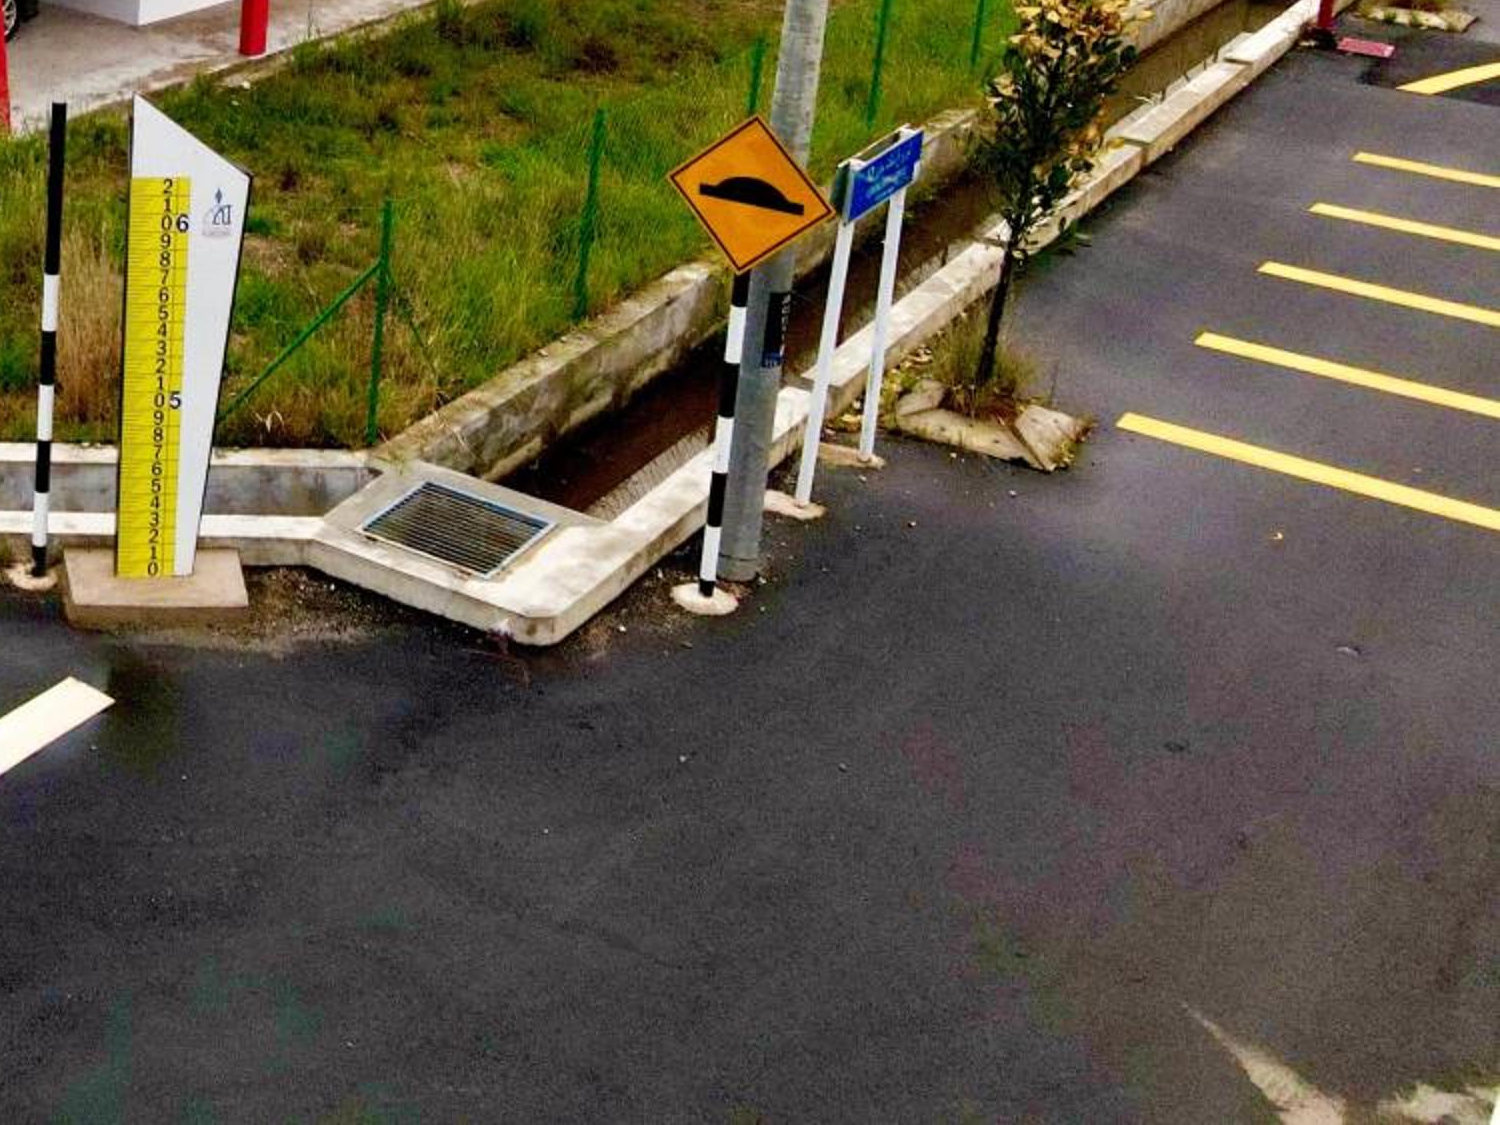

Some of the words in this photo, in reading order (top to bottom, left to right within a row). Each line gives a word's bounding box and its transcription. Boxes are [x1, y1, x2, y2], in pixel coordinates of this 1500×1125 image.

[164, 179, 172, 194] 2
[164, 198, 171, 212] 1
[162, 215, 172, 230] 0
[176, 213, 189, 233] 6
[161, 233, 170, 249] 9
[160, 251, 170, 267] 8
[161, 270, 169, 284] 7
[159, 287, 168, 302] 6
[159, 305, 168, 320] 5
[158, 323, 166, 336] 4
[158, 341, 166, 355] 3
[156, 358, 165, 373] 2
[157, 376, 164, 390] 1
[155, 393, 164, 407] 0
[169, 390, 181, 409] 5
[154, 411, 164, 425] 9
[154, 427, 163, 443] 8
[154, 445, 163, 459] 7
[152, 461, 162, 476] 6
[152, 478, 160, 493] 5
[151, 496, 159, 509] 4
[150, 512, 158, 526] 3
[150, 529, 158, 543] 2
[151, 547, 157, 559] 1
[148, 563, 158, 576] 0
